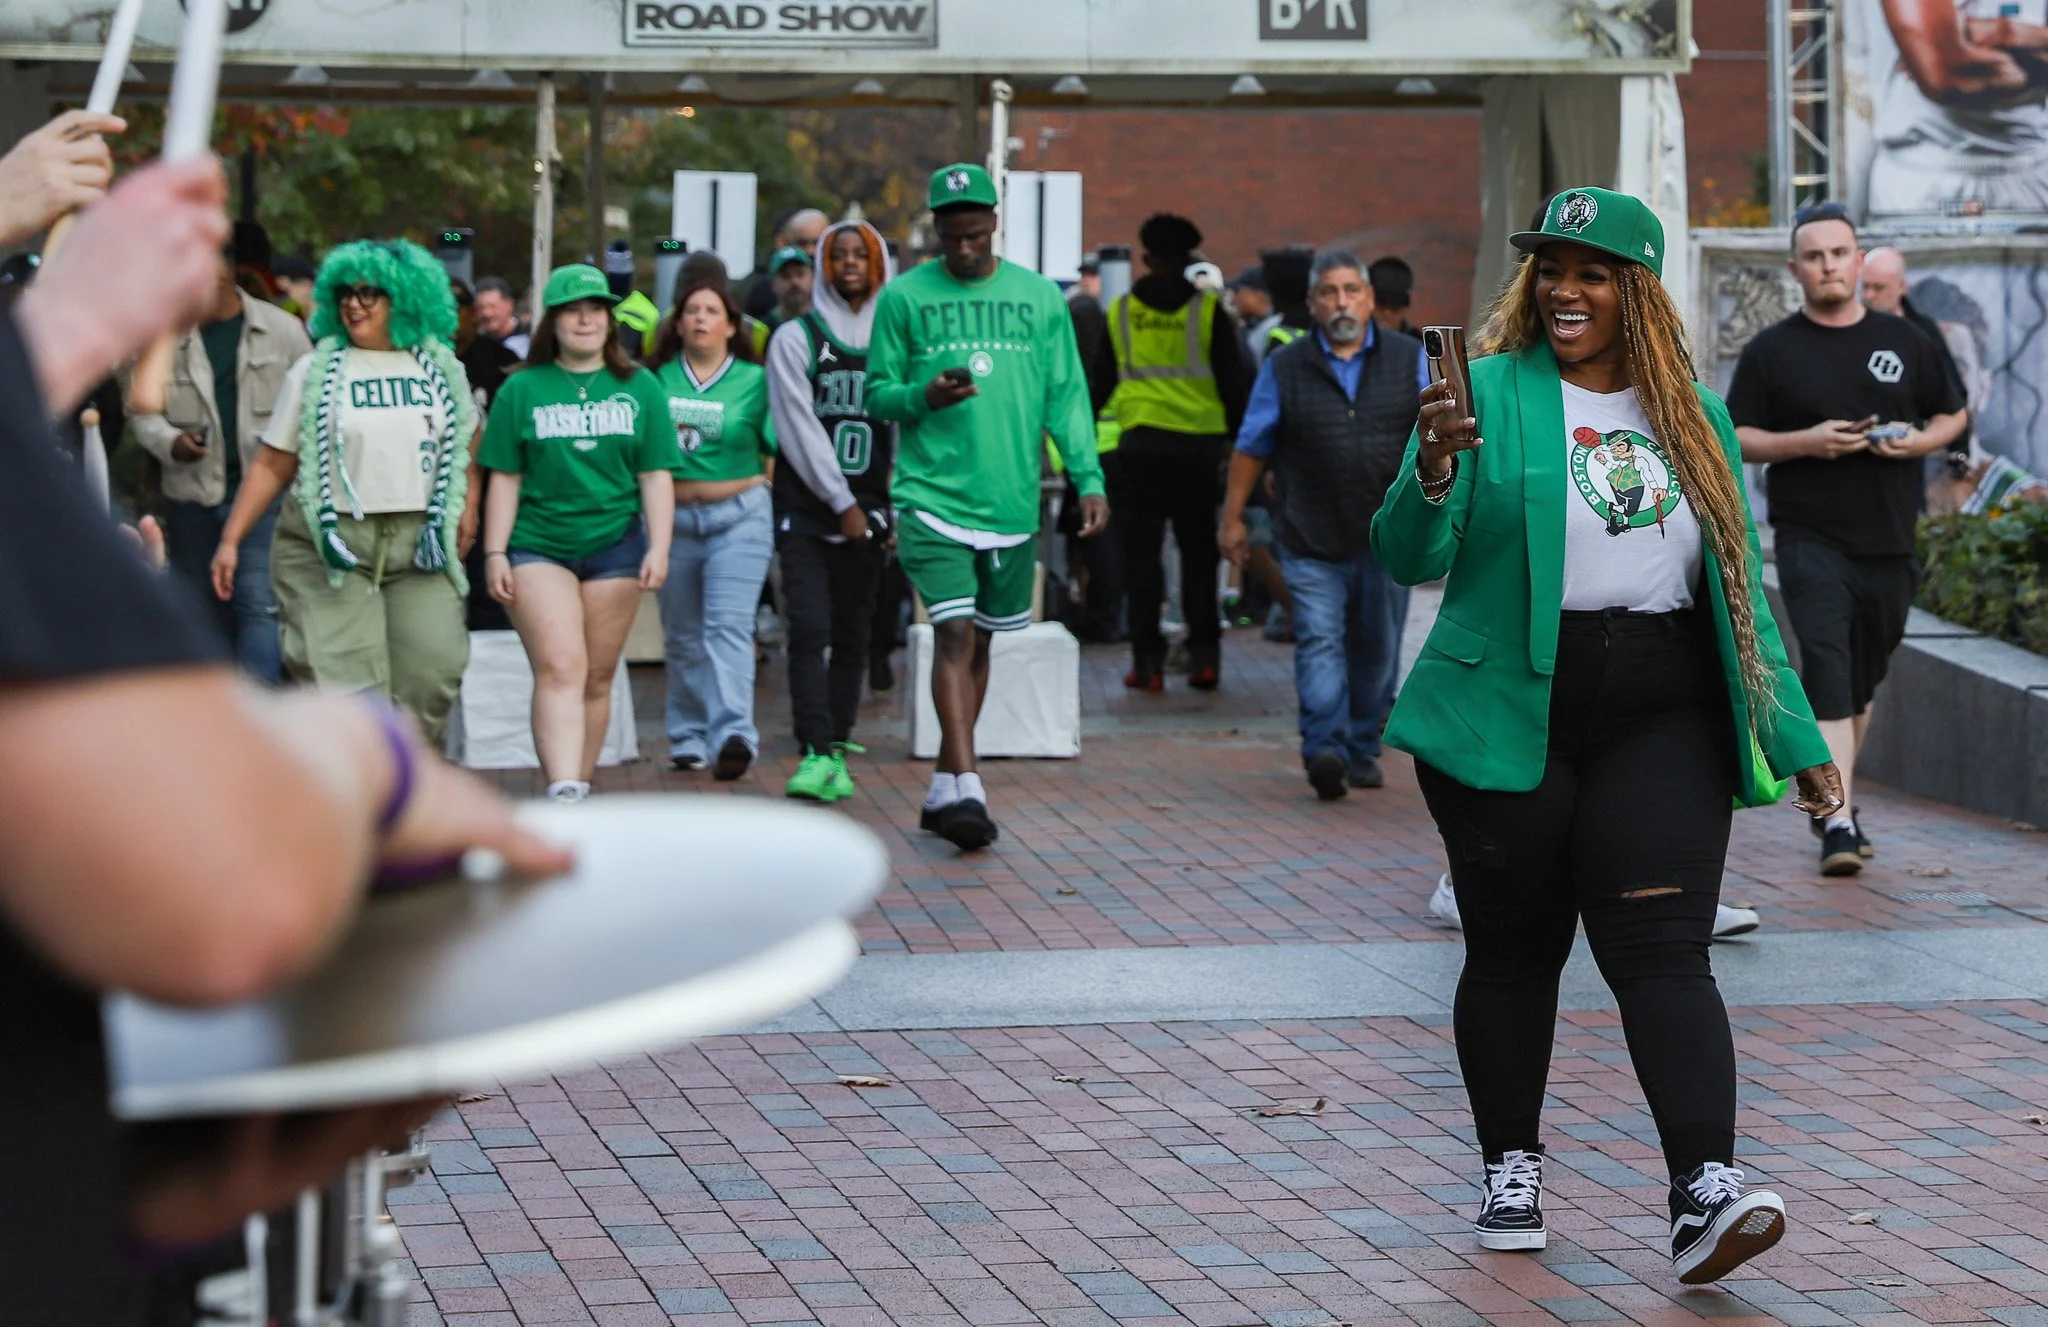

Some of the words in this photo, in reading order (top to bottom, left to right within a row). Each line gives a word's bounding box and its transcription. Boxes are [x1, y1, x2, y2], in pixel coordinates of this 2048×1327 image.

[636, 4, 766, 29] ROAD
[778, 5, 926, 31] SHOW
[920, 300, 1034, 340] CELTICS
[350, 377, 434, 408] CELTICS
[833, 420, 872, 475] 0
[1572, 445, 1602, 507] BOSTON
